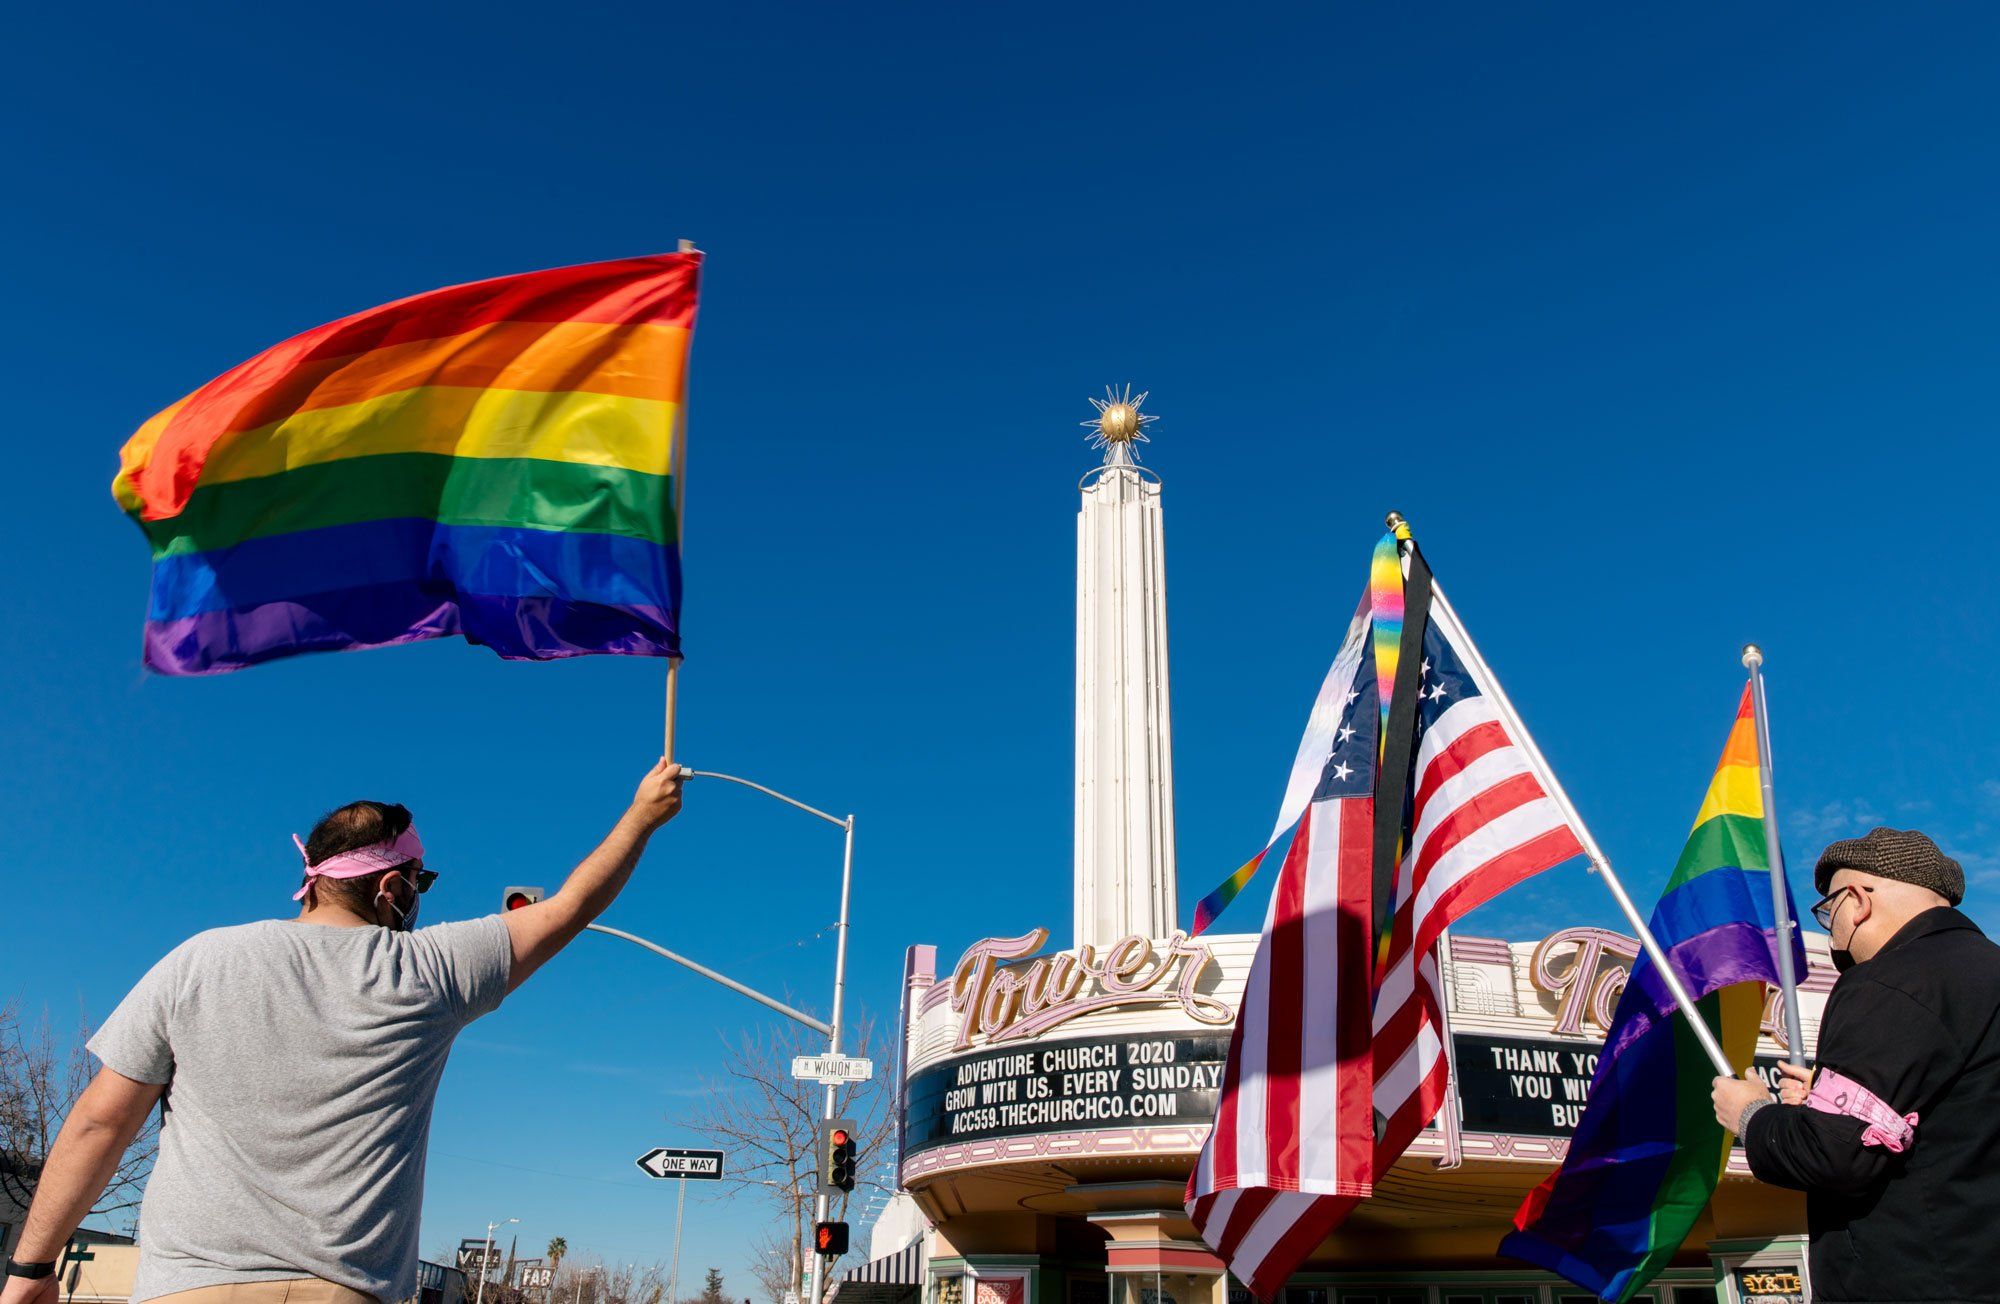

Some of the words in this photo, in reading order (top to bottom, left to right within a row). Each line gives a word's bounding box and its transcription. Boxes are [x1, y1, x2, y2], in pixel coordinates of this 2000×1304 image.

[951, 927, 1235, 1053] Tower
[815, 1061, 850, 1076] WISHON
[957, 1053, 1035, 1086] ADVENTURE
[1043, 1044, 1117, 1073] CHURCH
[1128, 1040, 1175, 1065] 2020
[1490, 1047, 1562, 1074] THANK
[1571, 1053, 1599, 1076] YO
[945, 1086, 976, 1112] GROW
[983, 1080, 1017, 1105] WITH
[1026, 1076, 1053, 1099] US,
[1063, 1069, 1121, 1096] EVERY
[1132, 1065, 1222, 1091] SUNDAY
[1511, 1075, 1552, 1099] YOU
[952, 1093, 1177, 1134] ACC559.THECHURCHCO.COM
[662, 1158, 685, 1170] ONE
[690, 1159, 713, 1171] WAY
[522, 1268, 551, 1287] FAB
[1745, 1273, 1796, 1294] Y&T
